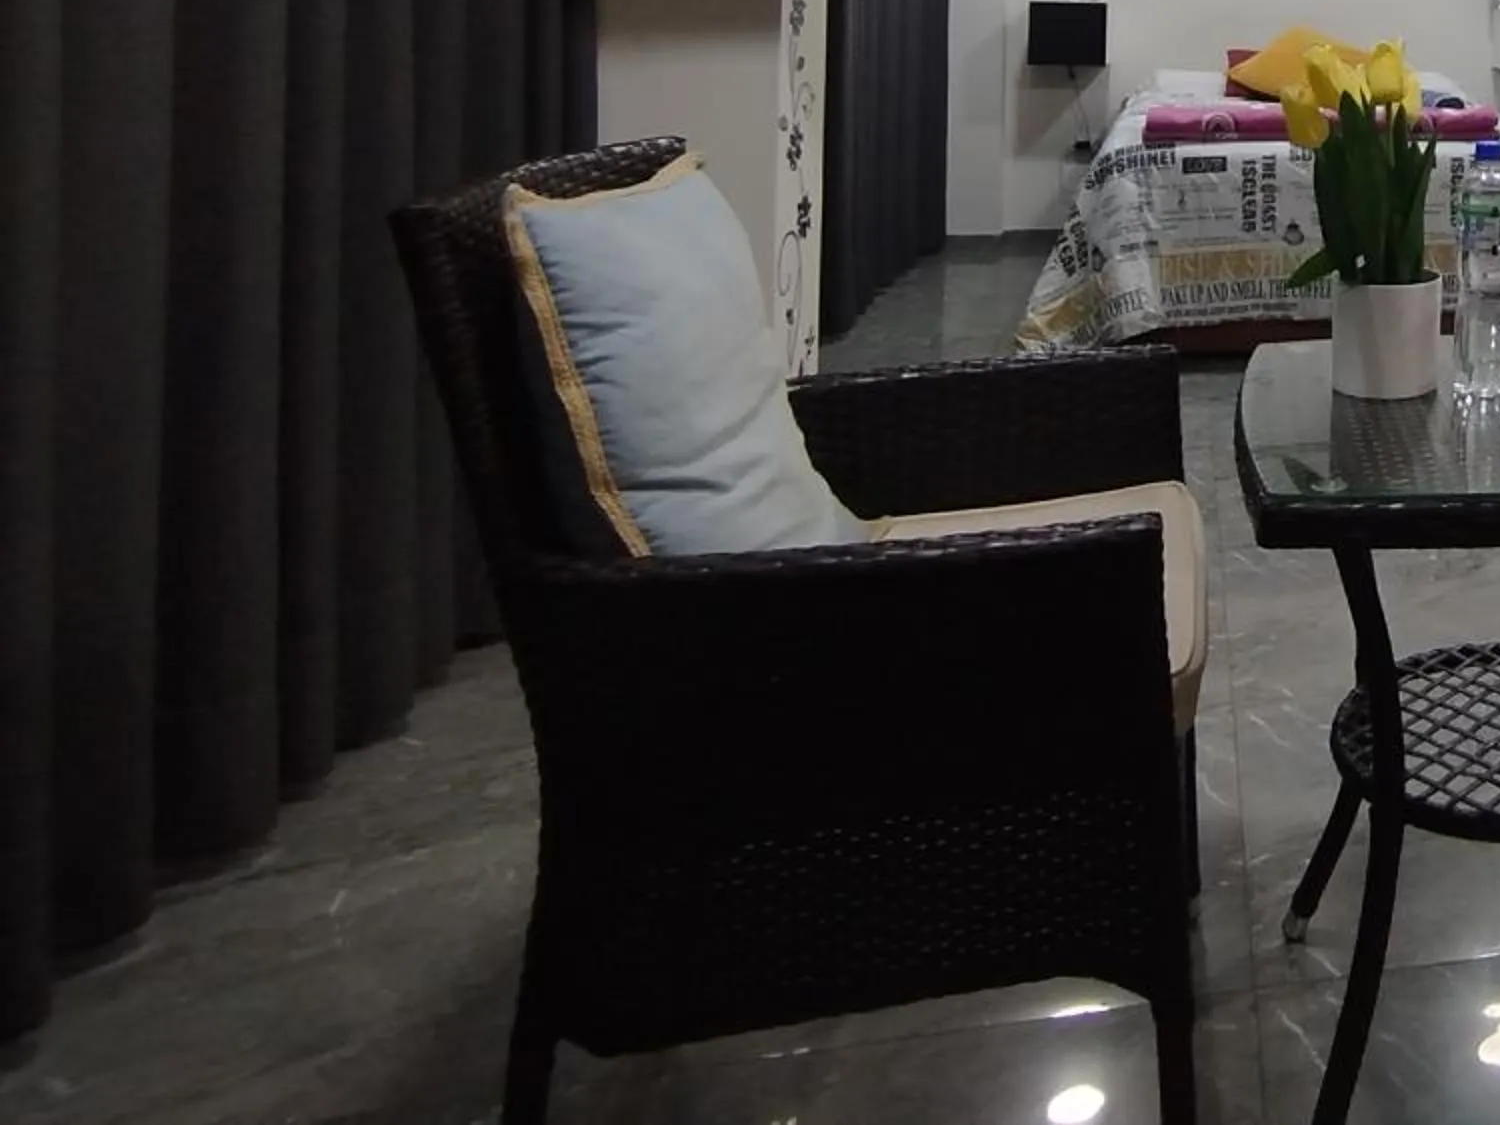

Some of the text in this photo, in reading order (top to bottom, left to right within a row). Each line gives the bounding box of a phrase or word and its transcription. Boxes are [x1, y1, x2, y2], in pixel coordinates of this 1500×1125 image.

[1261, 155, 1277, 234] THE COAST
[1207, 280, 1229, 304] AND
